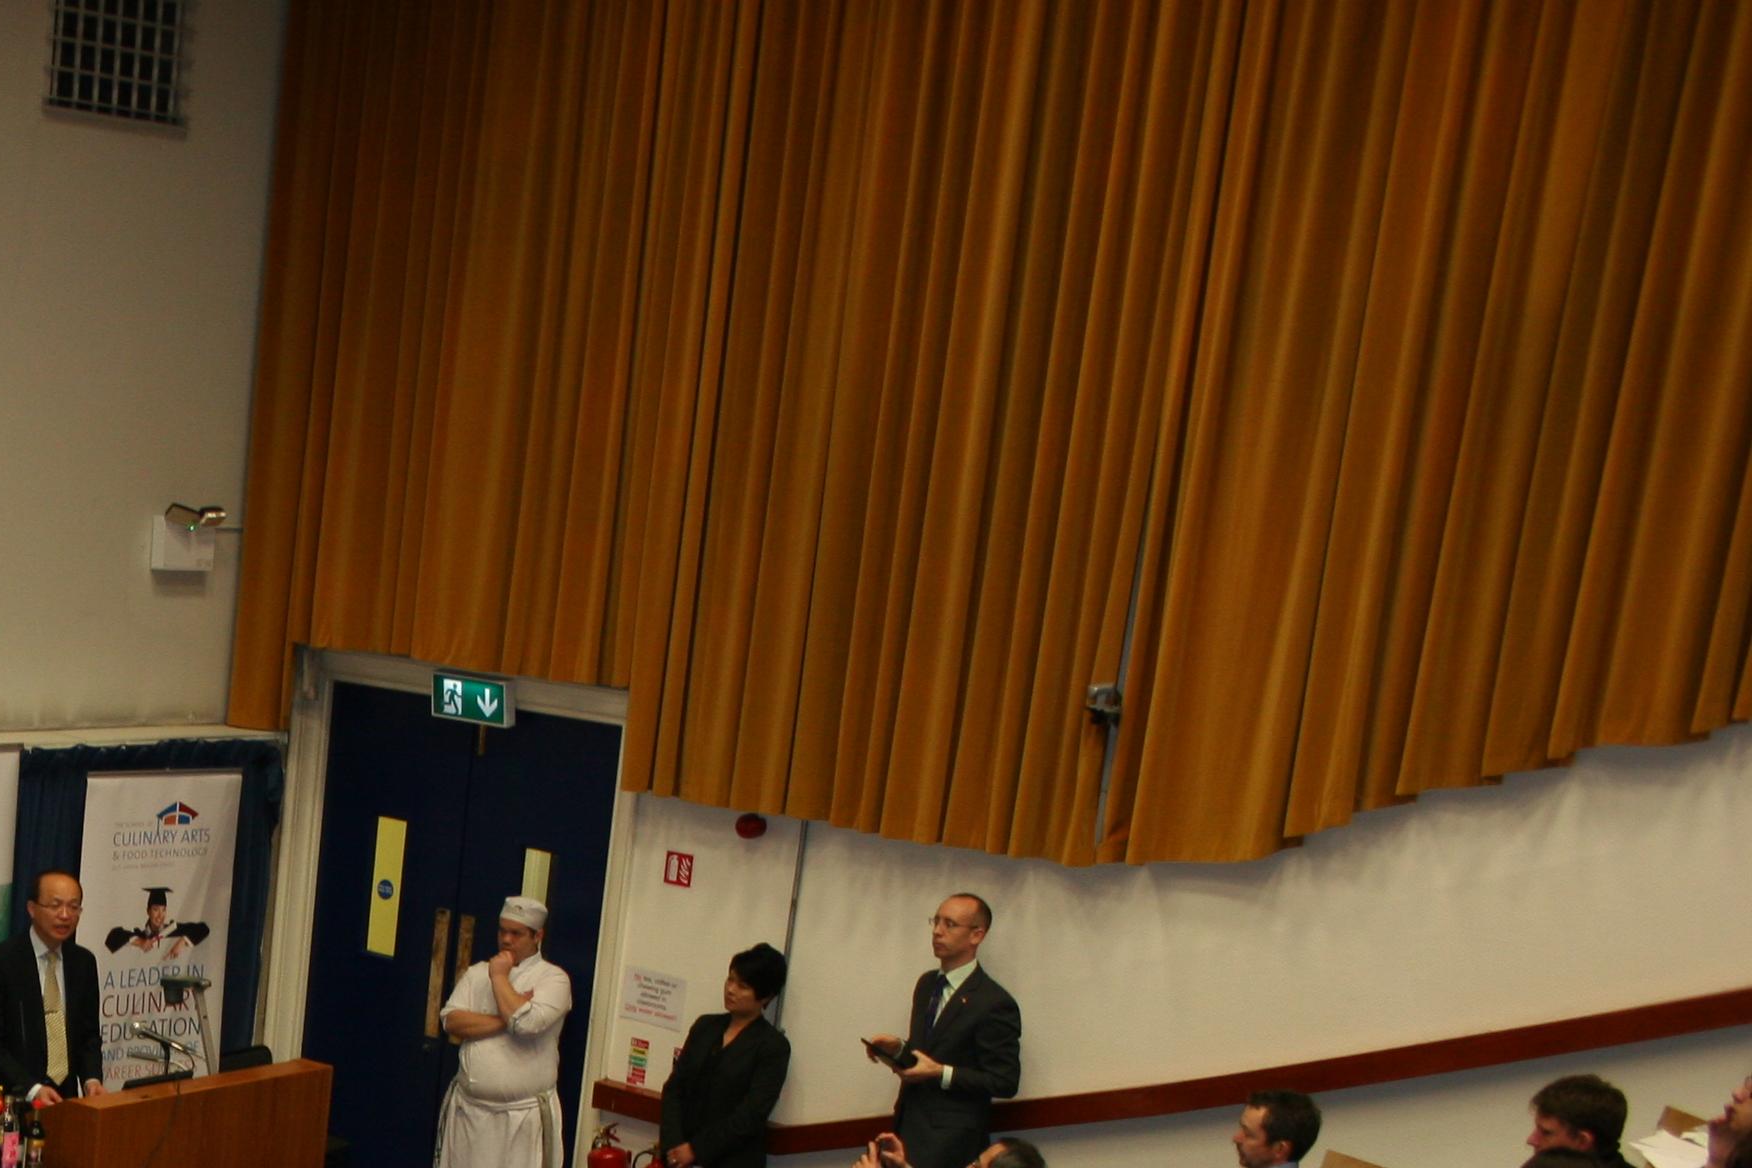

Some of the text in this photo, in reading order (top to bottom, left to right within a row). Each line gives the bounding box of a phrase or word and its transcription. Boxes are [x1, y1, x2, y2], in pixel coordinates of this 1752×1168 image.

[113, 827, 211, 847] CULINARY ARTS
[122, 849, 148, 861] FOOD
[150, 846, 209, 860] TECHNOLOGY
[103, 971, 115, 990] A
